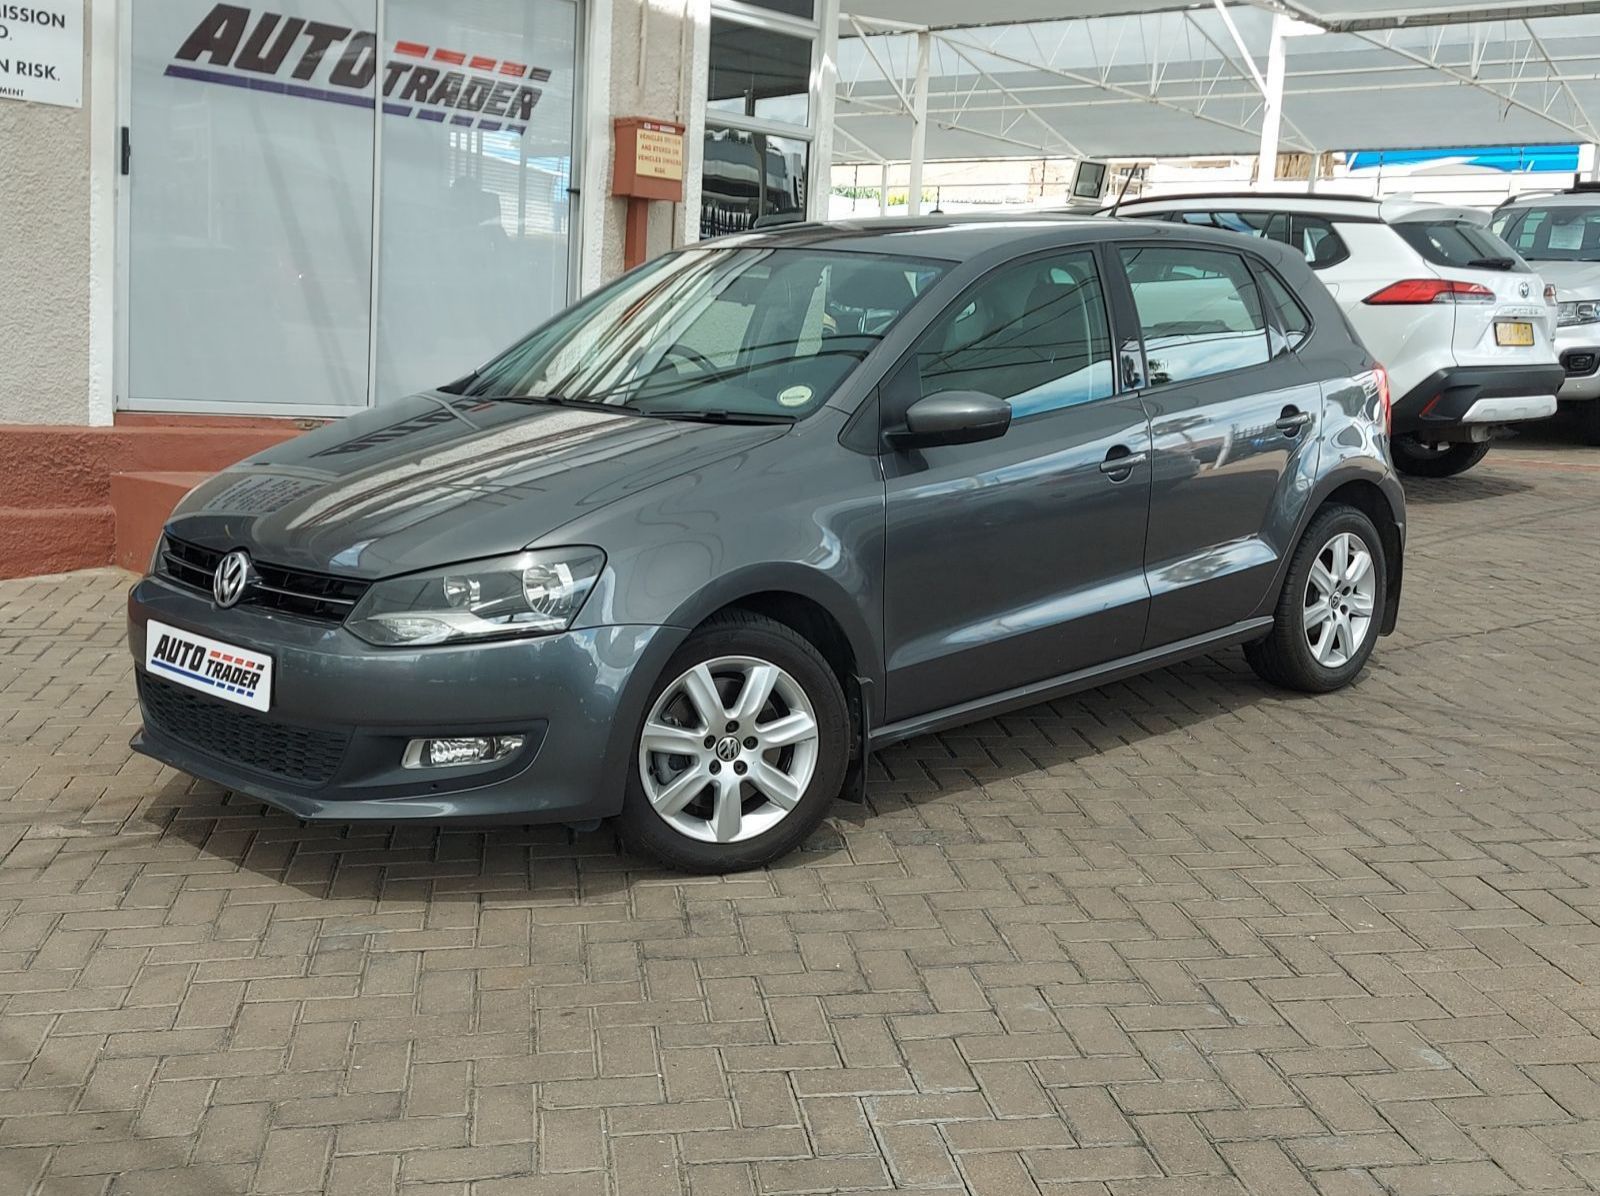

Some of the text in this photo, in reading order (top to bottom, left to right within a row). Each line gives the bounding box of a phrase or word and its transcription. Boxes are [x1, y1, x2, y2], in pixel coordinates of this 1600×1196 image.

[0, 4, 65, 28] ISSION
[17, 61, 61, 81] RISK.
[175, 3, 543, 121] AUTO TRADER
[153, 634, 261, 690] AUTO TRADER
